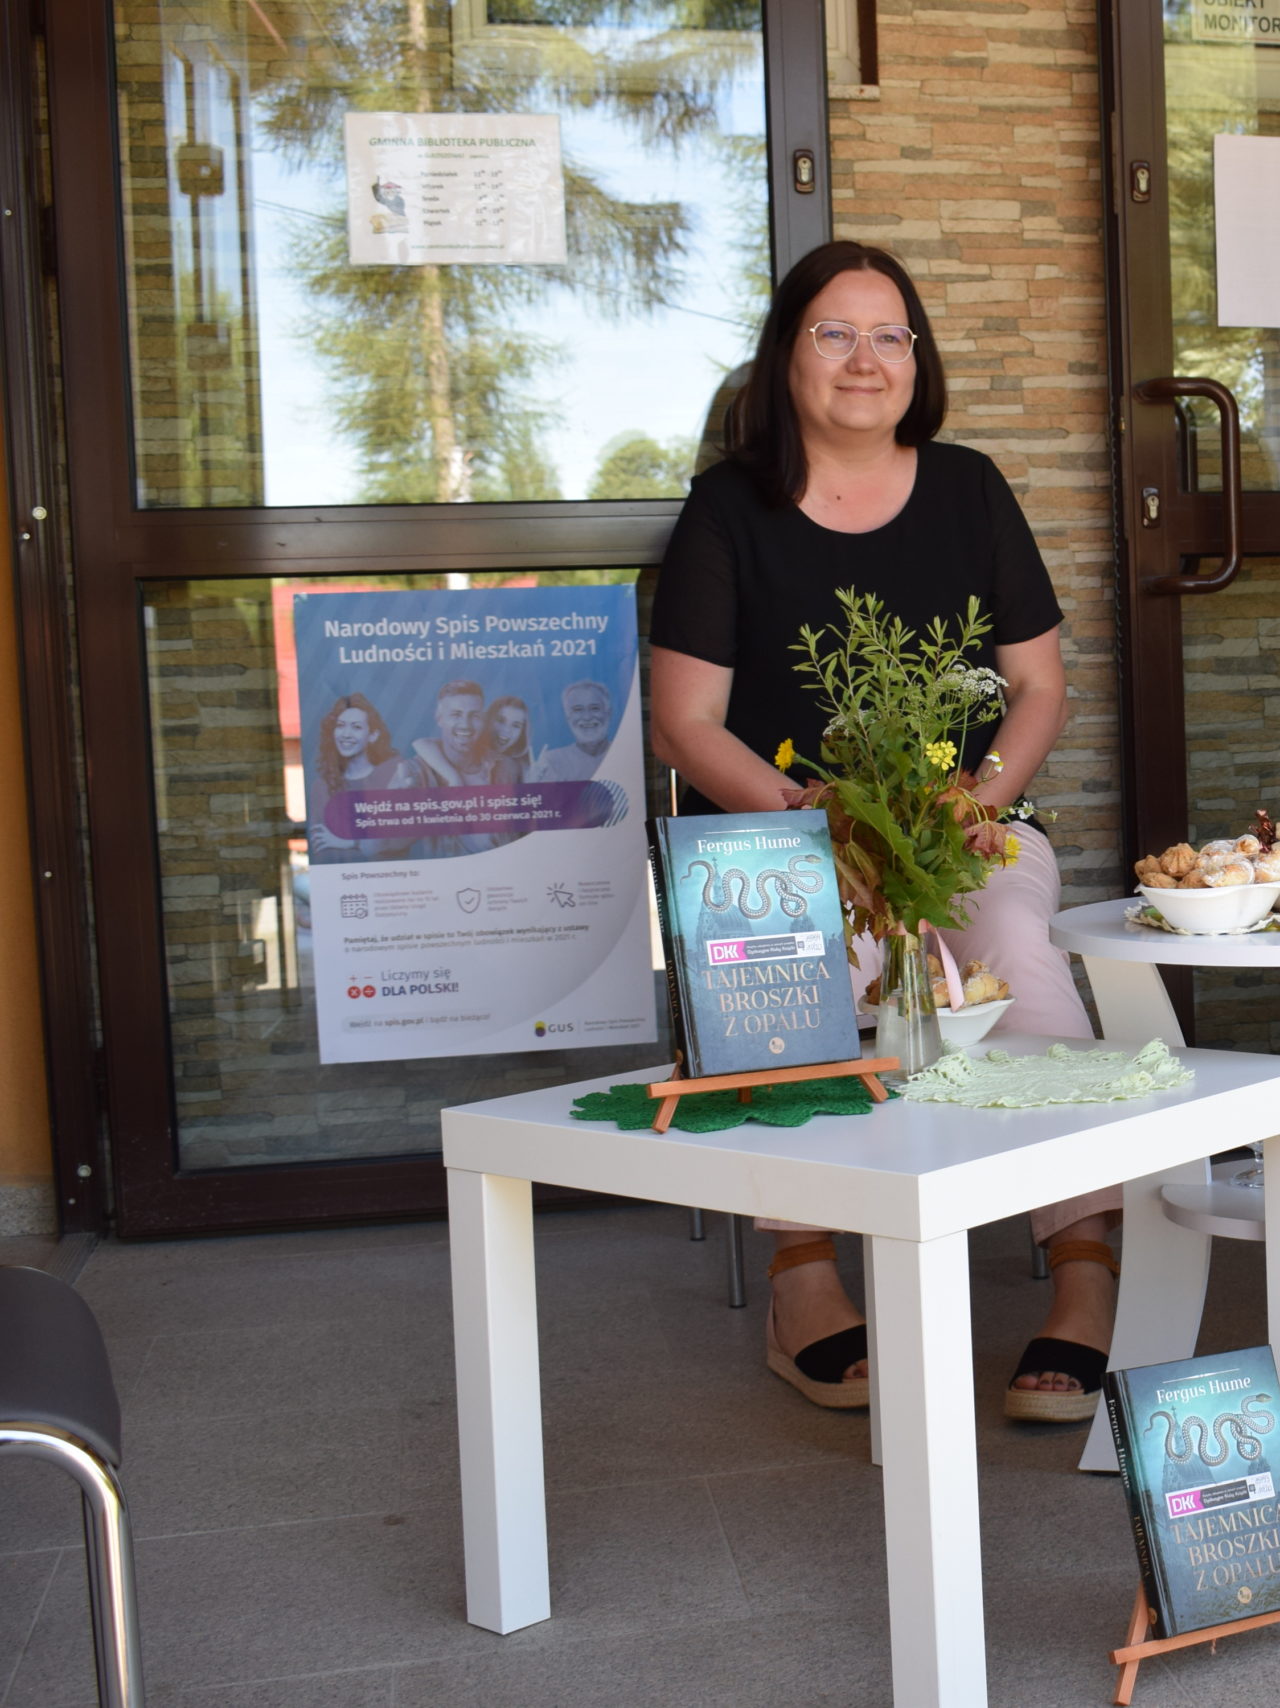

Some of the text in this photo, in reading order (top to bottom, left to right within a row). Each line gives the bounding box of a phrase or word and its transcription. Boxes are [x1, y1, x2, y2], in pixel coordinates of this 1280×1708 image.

[417, 137, 477, 147] BIBLIOTEKA
[479, 138, 536, 147] PUBLICZNA
[324, 612, 609, 639] Narodowy Spis Powszechny
[339, 638, 597, 664] Ludności i Mieszkań 2021
[354, 799, 392, 814] Wejdź
[395, 804, 411, 812] na
[413, 797, 478, 813] spis.gov.pl
[487, 797, 518, 810] spisz
[355, 817, 376, 829] Spis
[378, 816, 400, 827] trwa
[402, 815, 415, 825] od
[423, 813, 463, 824] kwietnia
[465, 813, 478, 822] do
[480, 813, 491, 822] 30
[493, 811, 530, 821] czerwca
[532, 810, 553, 819] 2021
[697, 836, 801, 855] Fergus Hume
[381, 967, 451, 982] Liczymy się
[702, 961, 831, 991] TAJEMNICA
[382, 985, 407, 996] DLA
[719, 984, 820, 1013] BROSZKI
[548, 1022, 574, 1033] GUS
[724, 1008, 821, 1037] Z OPALU
[1156, 1376, 1251, 1404] Fergus Hume
[1188, 1529, 1280, 1567] BROSZKI
[1196, 1569, 1209, 1592] Z
